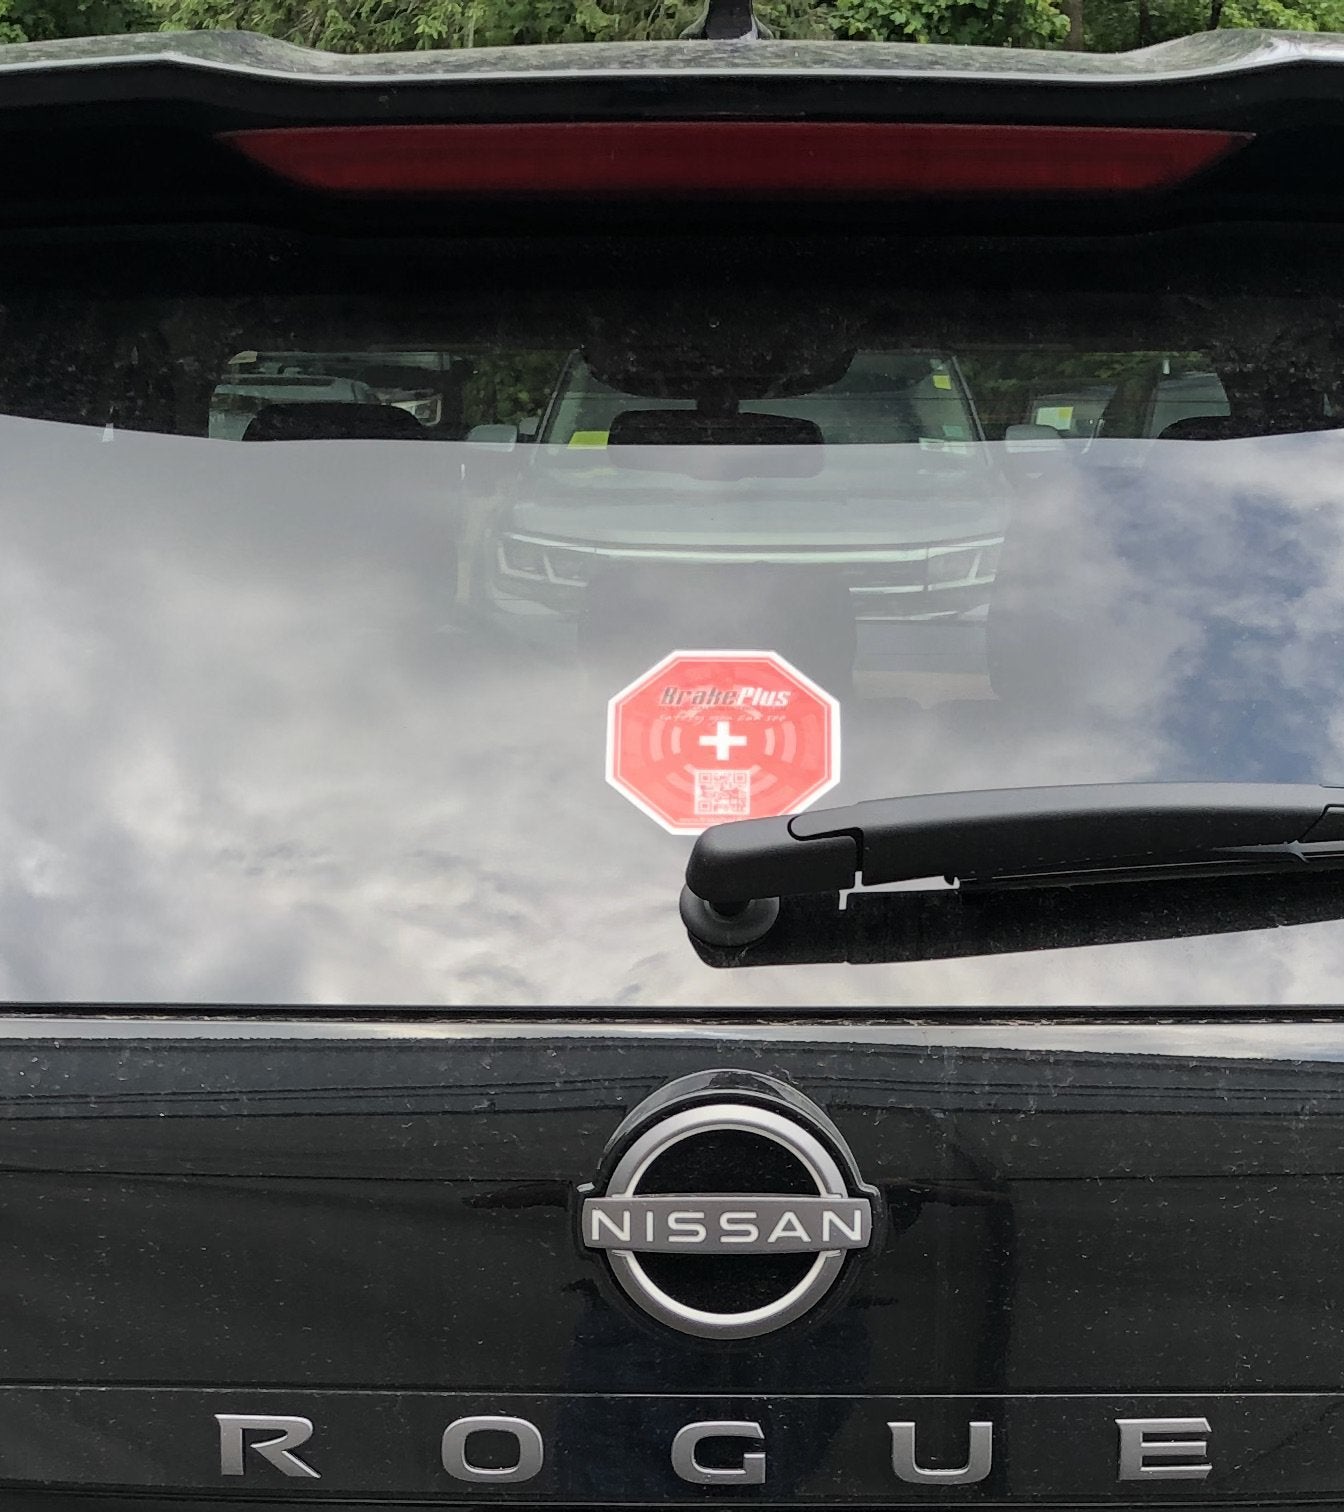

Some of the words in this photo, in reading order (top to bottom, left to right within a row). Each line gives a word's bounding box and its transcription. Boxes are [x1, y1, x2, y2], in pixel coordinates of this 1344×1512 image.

[660, 686, 791, 707] BrakePlus
[591, 1208, 863, 1244] NISSAN
[214, 1413, 1214, 1485] ROGUE
